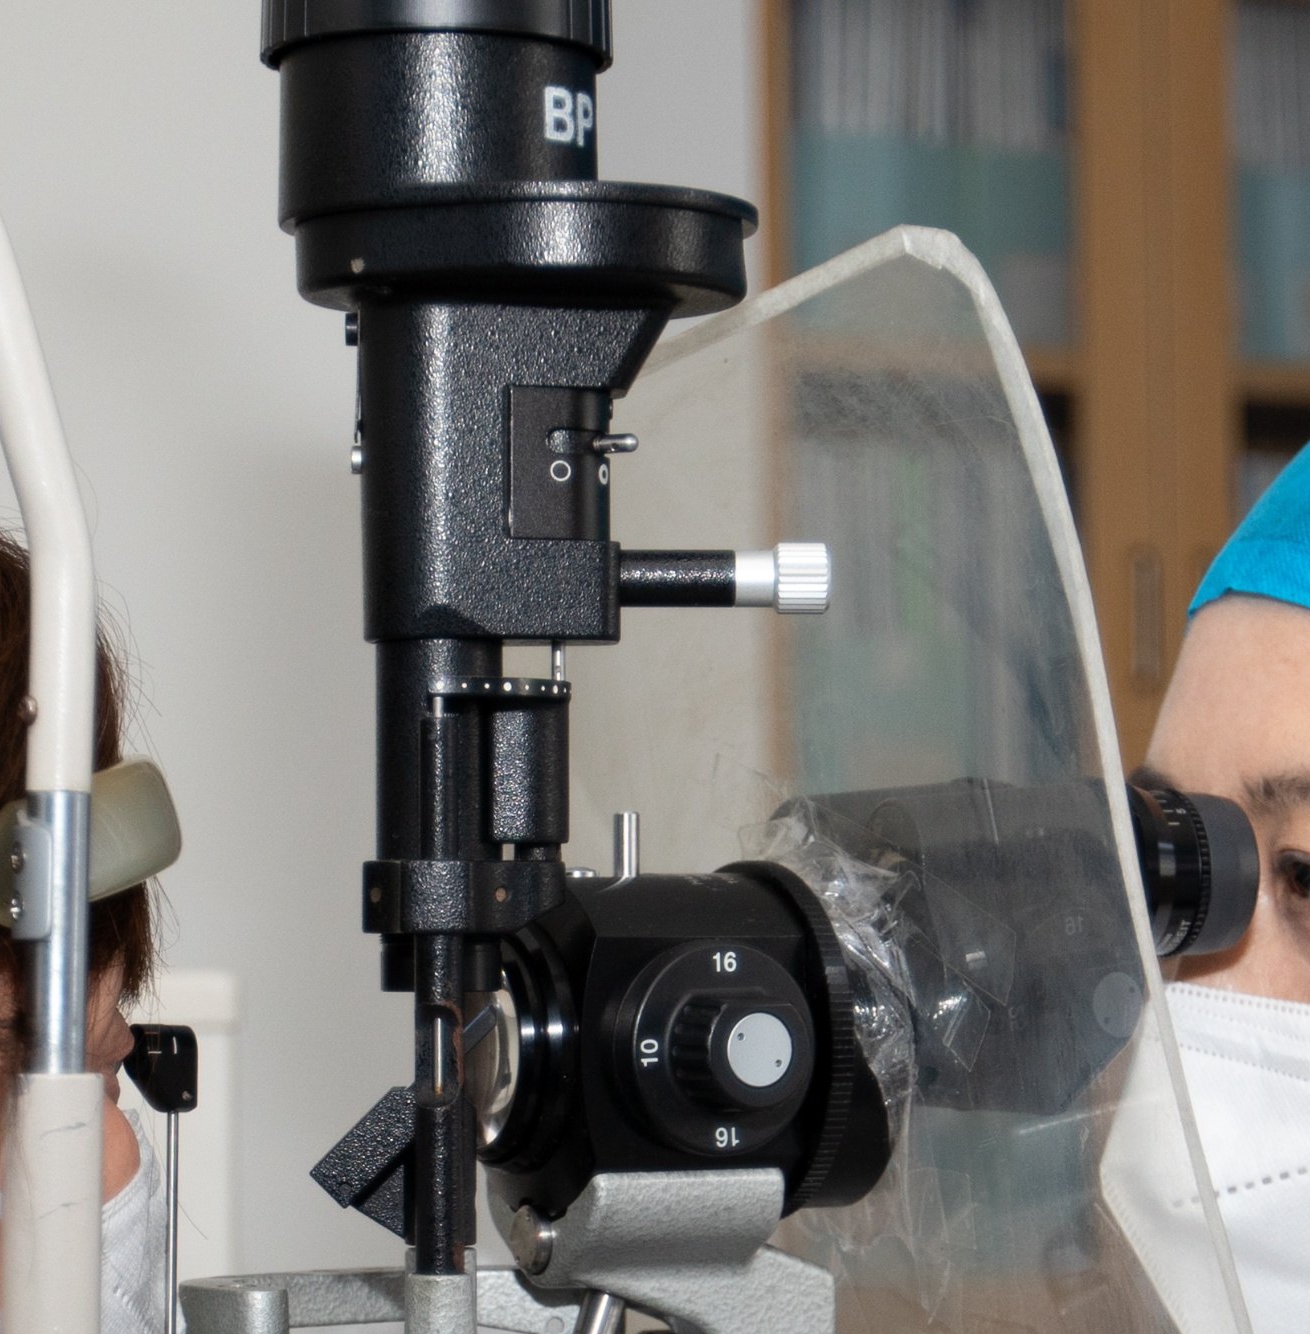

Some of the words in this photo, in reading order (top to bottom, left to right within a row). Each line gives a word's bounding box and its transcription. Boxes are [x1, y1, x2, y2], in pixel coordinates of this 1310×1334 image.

[544, 85, 594, 148] BP
[712, 951, 737, 973] 16
[640, 1038, 659, 1067] 10
[715, 1126, 740, 1148] 16
